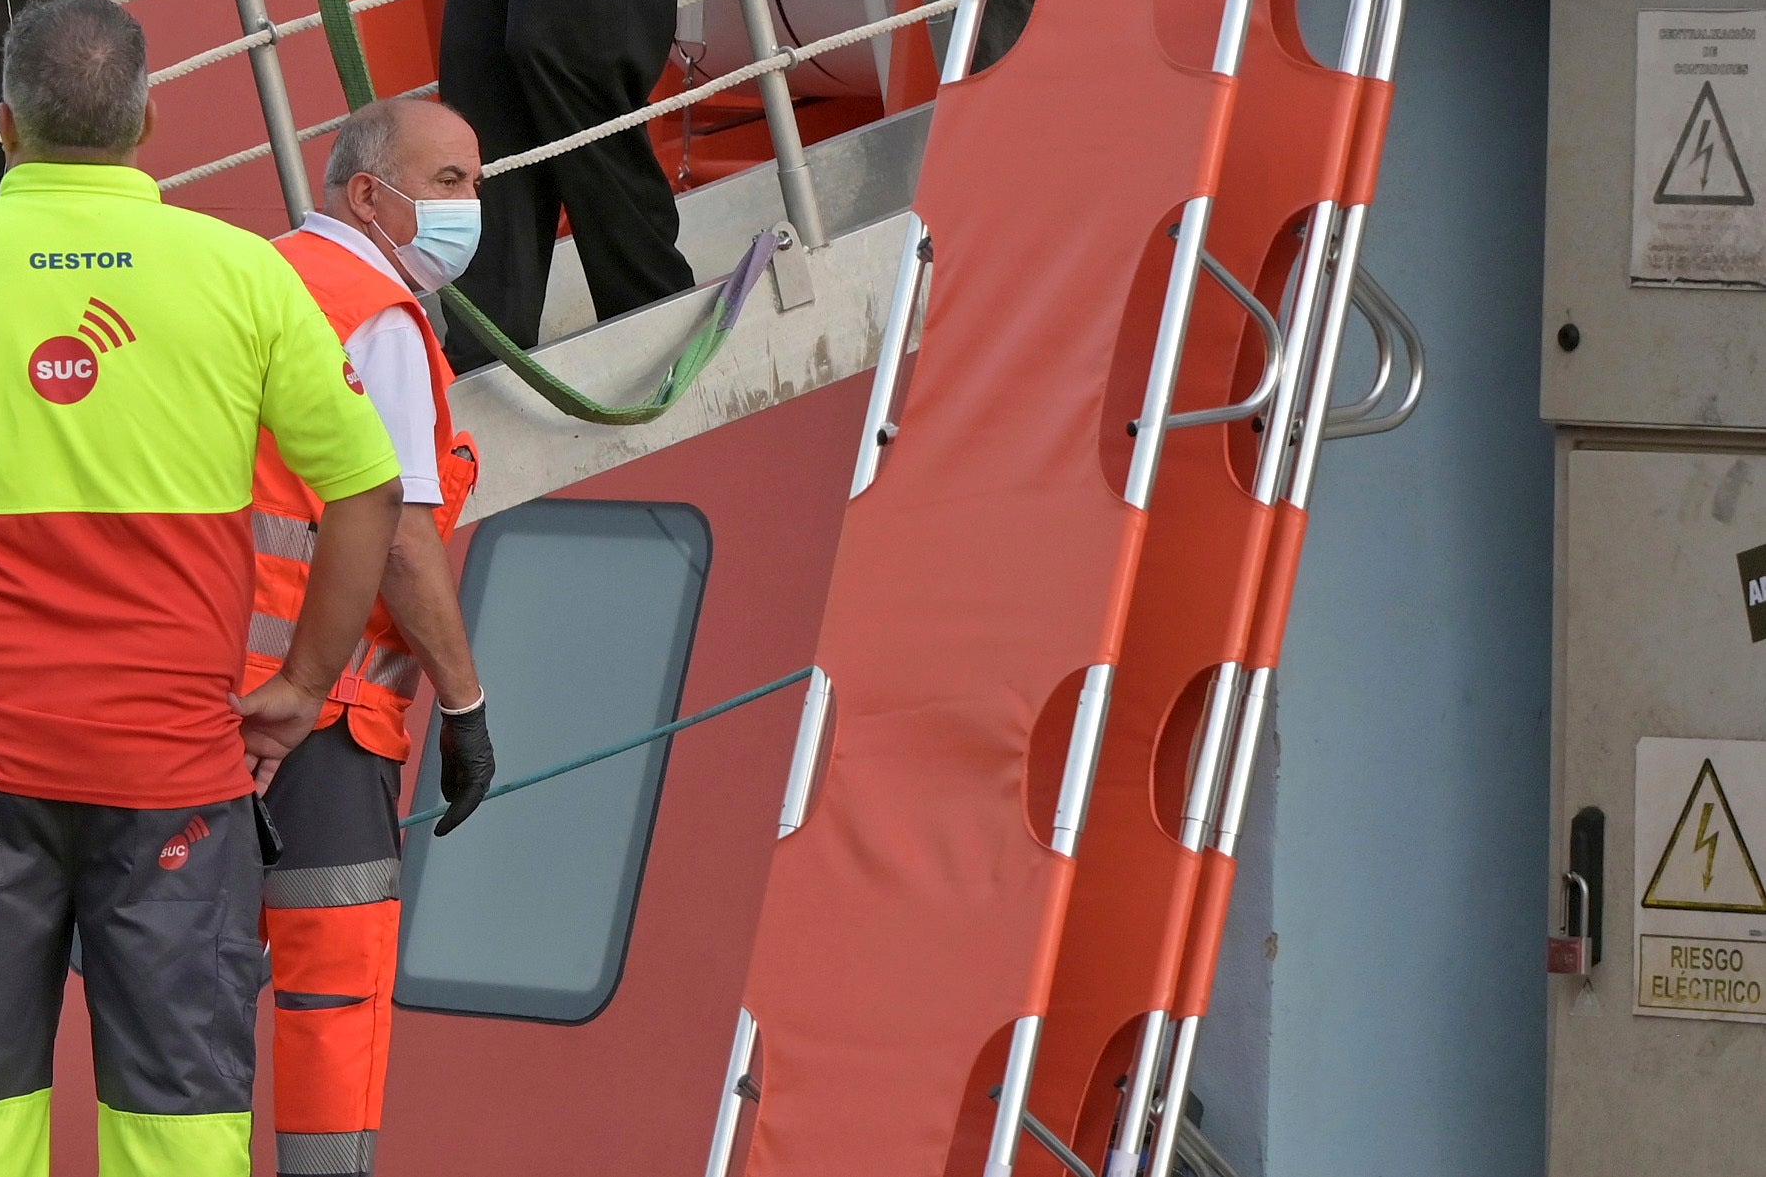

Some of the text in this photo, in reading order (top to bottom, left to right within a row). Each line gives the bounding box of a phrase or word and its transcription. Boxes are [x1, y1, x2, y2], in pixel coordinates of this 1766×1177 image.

[29, 251, 133, 270] GESTOR
[36, 358, 93, 380] SUC
[160, 845, 186, 858] SUC
[1670, 945, 1743, 972] RIESGO
[1651, 970, 1761, 1004] ELÉCTRICO
